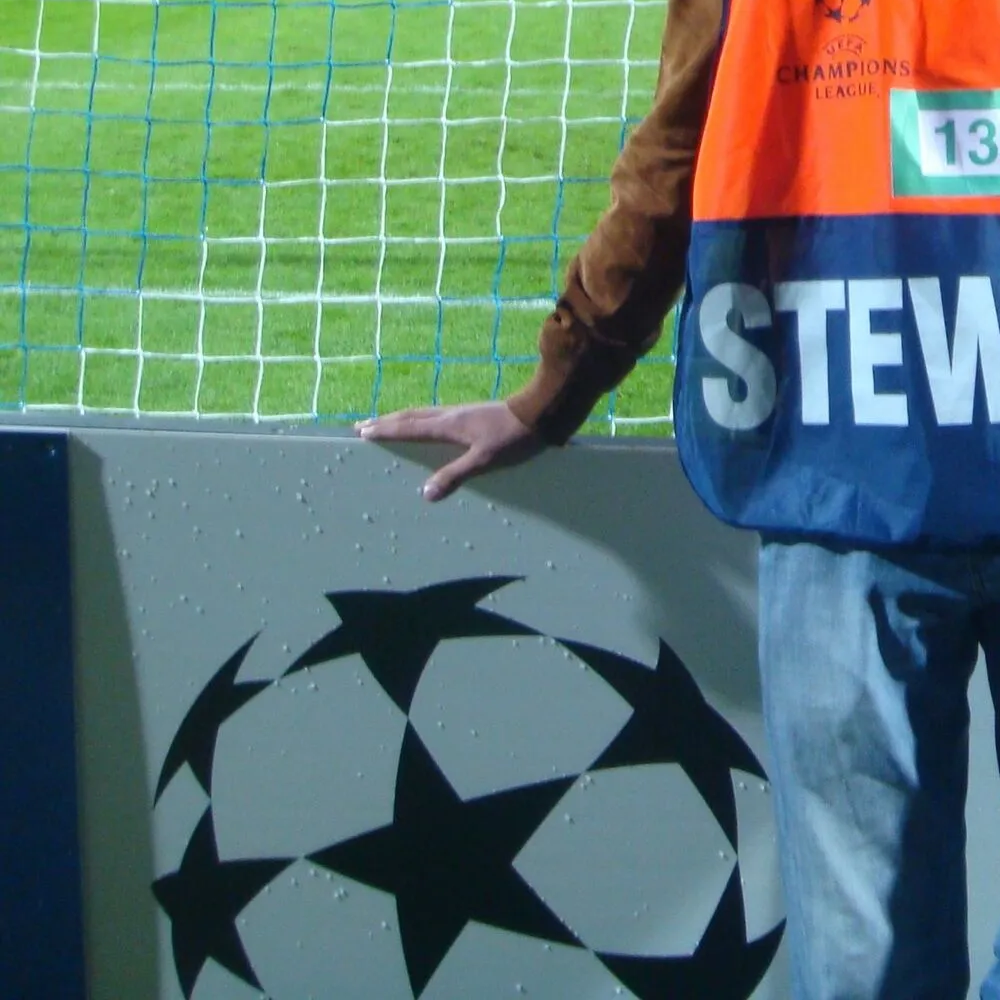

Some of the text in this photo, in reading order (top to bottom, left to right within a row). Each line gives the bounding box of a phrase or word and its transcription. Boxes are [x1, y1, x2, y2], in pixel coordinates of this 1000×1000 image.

[824, 35, 868, 56] UEFA
[776, 59, 912, 84] CHAMPIONS
[815, 83, 877, 100] LEAGUE
